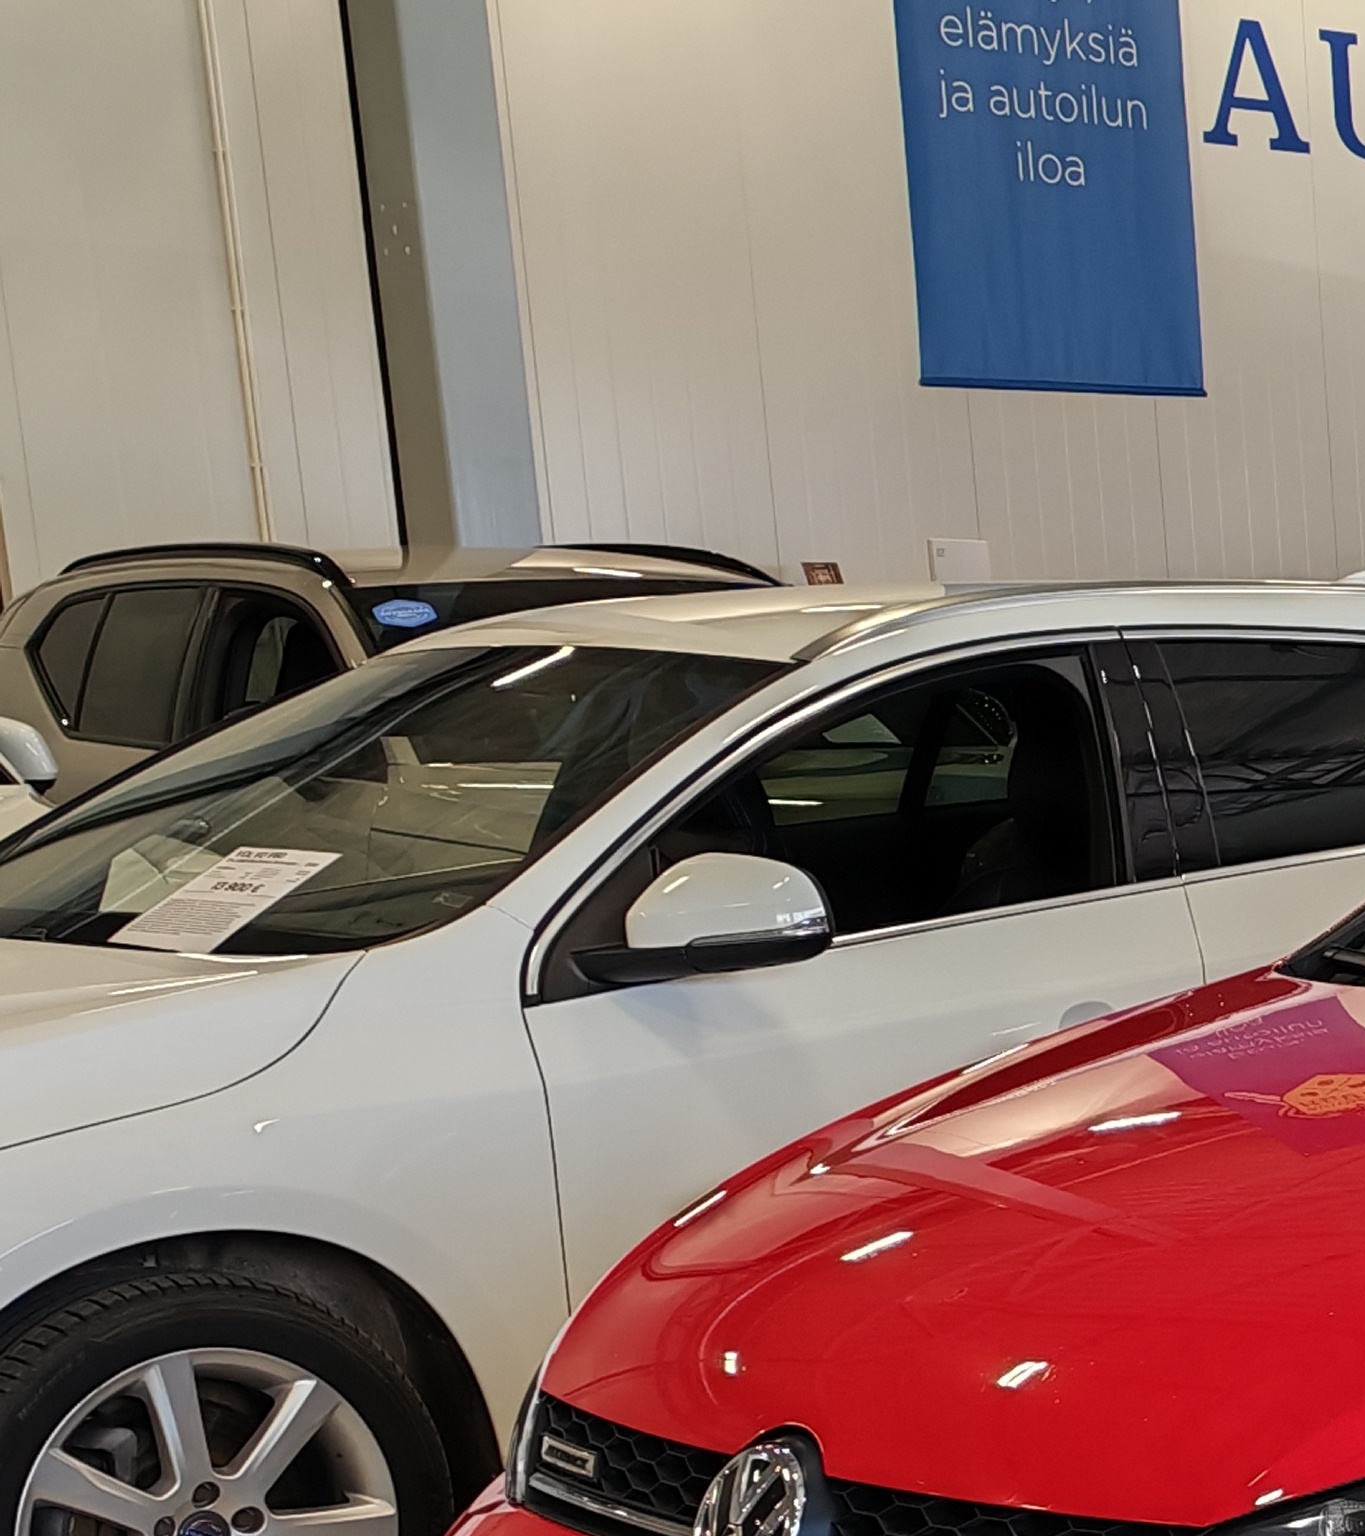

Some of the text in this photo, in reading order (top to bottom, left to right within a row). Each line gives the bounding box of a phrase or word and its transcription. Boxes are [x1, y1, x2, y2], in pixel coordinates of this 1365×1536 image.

[939, 5, 1139, 67] elämyksiä
[938, 69, 1148, 130] ja autoilun
[1016, 141, 1086, 186] iloa
